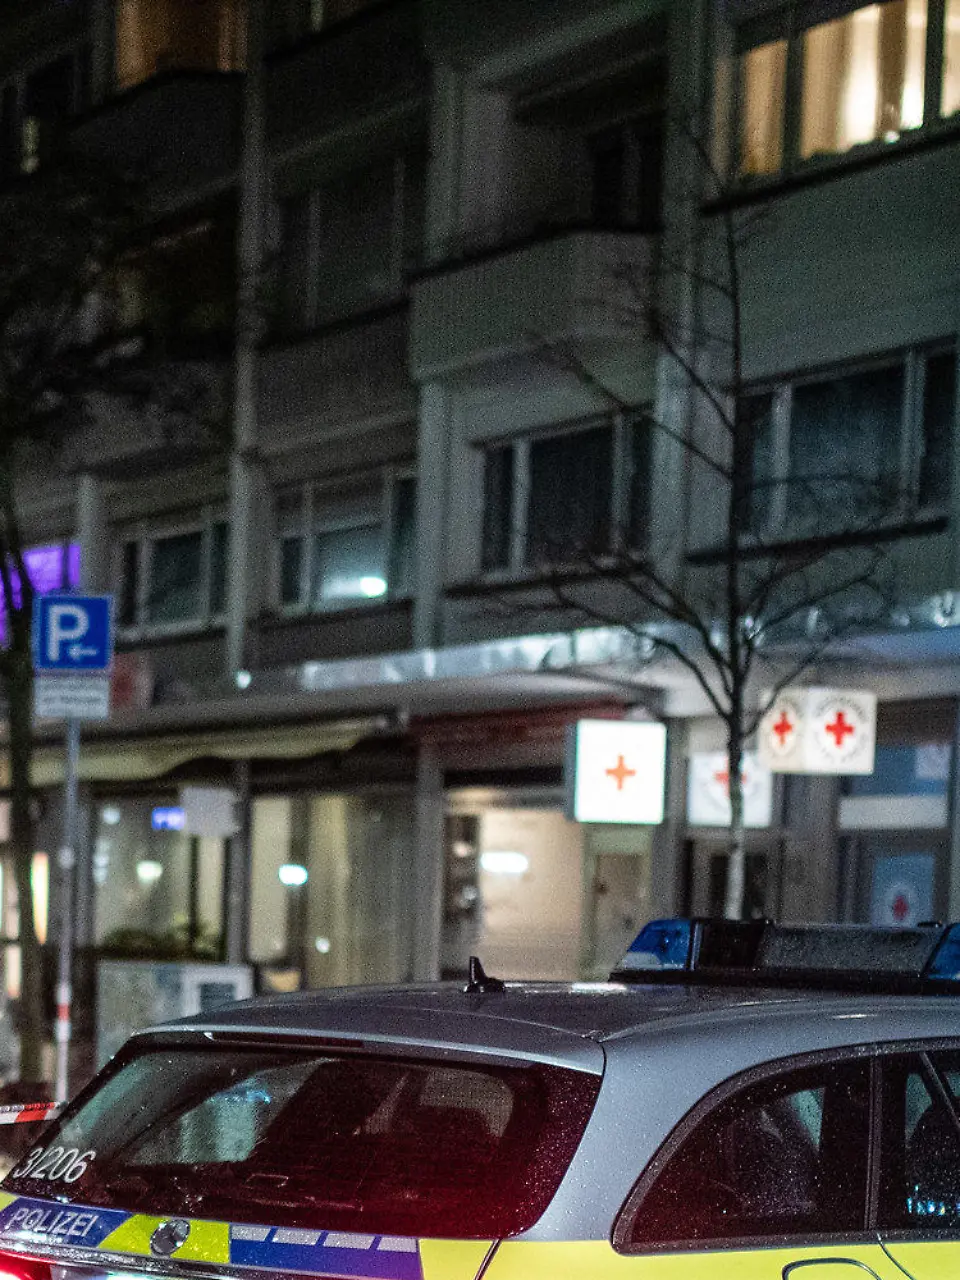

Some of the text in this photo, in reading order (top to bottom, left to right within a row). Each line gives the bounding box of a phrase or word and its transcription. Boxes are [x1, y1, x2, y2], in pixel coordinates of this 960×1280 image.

[48, 604, 88, 662] P
[13, 1146, 97, 1184] 3/206
[4, 1207, 100, 1238] POLIZEI
